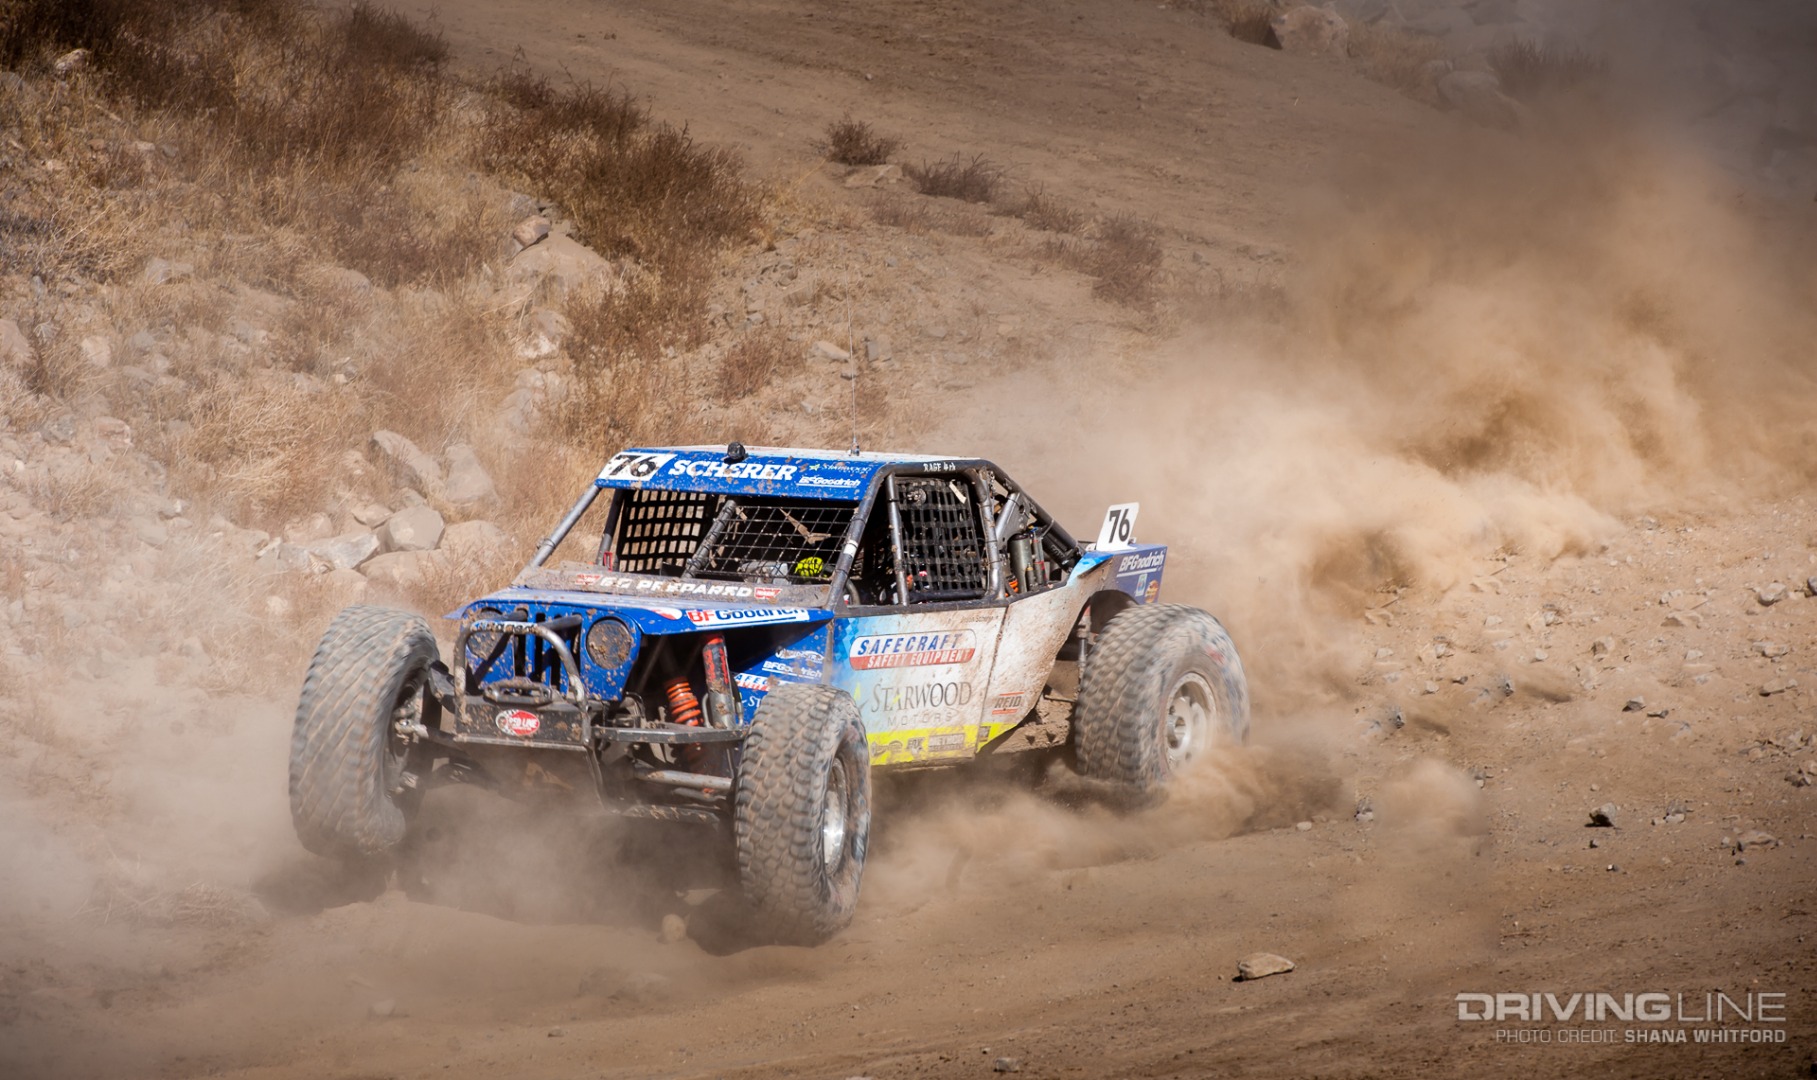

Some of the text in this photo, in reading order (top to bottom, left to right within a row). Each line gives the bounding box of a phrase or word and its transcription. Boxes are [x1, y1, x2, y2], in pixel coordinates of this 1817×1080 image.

[609, 454, 658, 477] 76
[668, 459, 798, 481] SCHERER
[1108, 508, 1130, 544] 76
[1119, 552, 1165, 572] BFGoodrich
[857, 633, 963, 656] SAFECRAFT
[867, 648, 970, 669] SAFETY EQUIPMENT
[871, 682, 973, 713] STARWOOD
[994, 695, 1022, 709] REID
[888, 711, 954, 726] MOTORS
